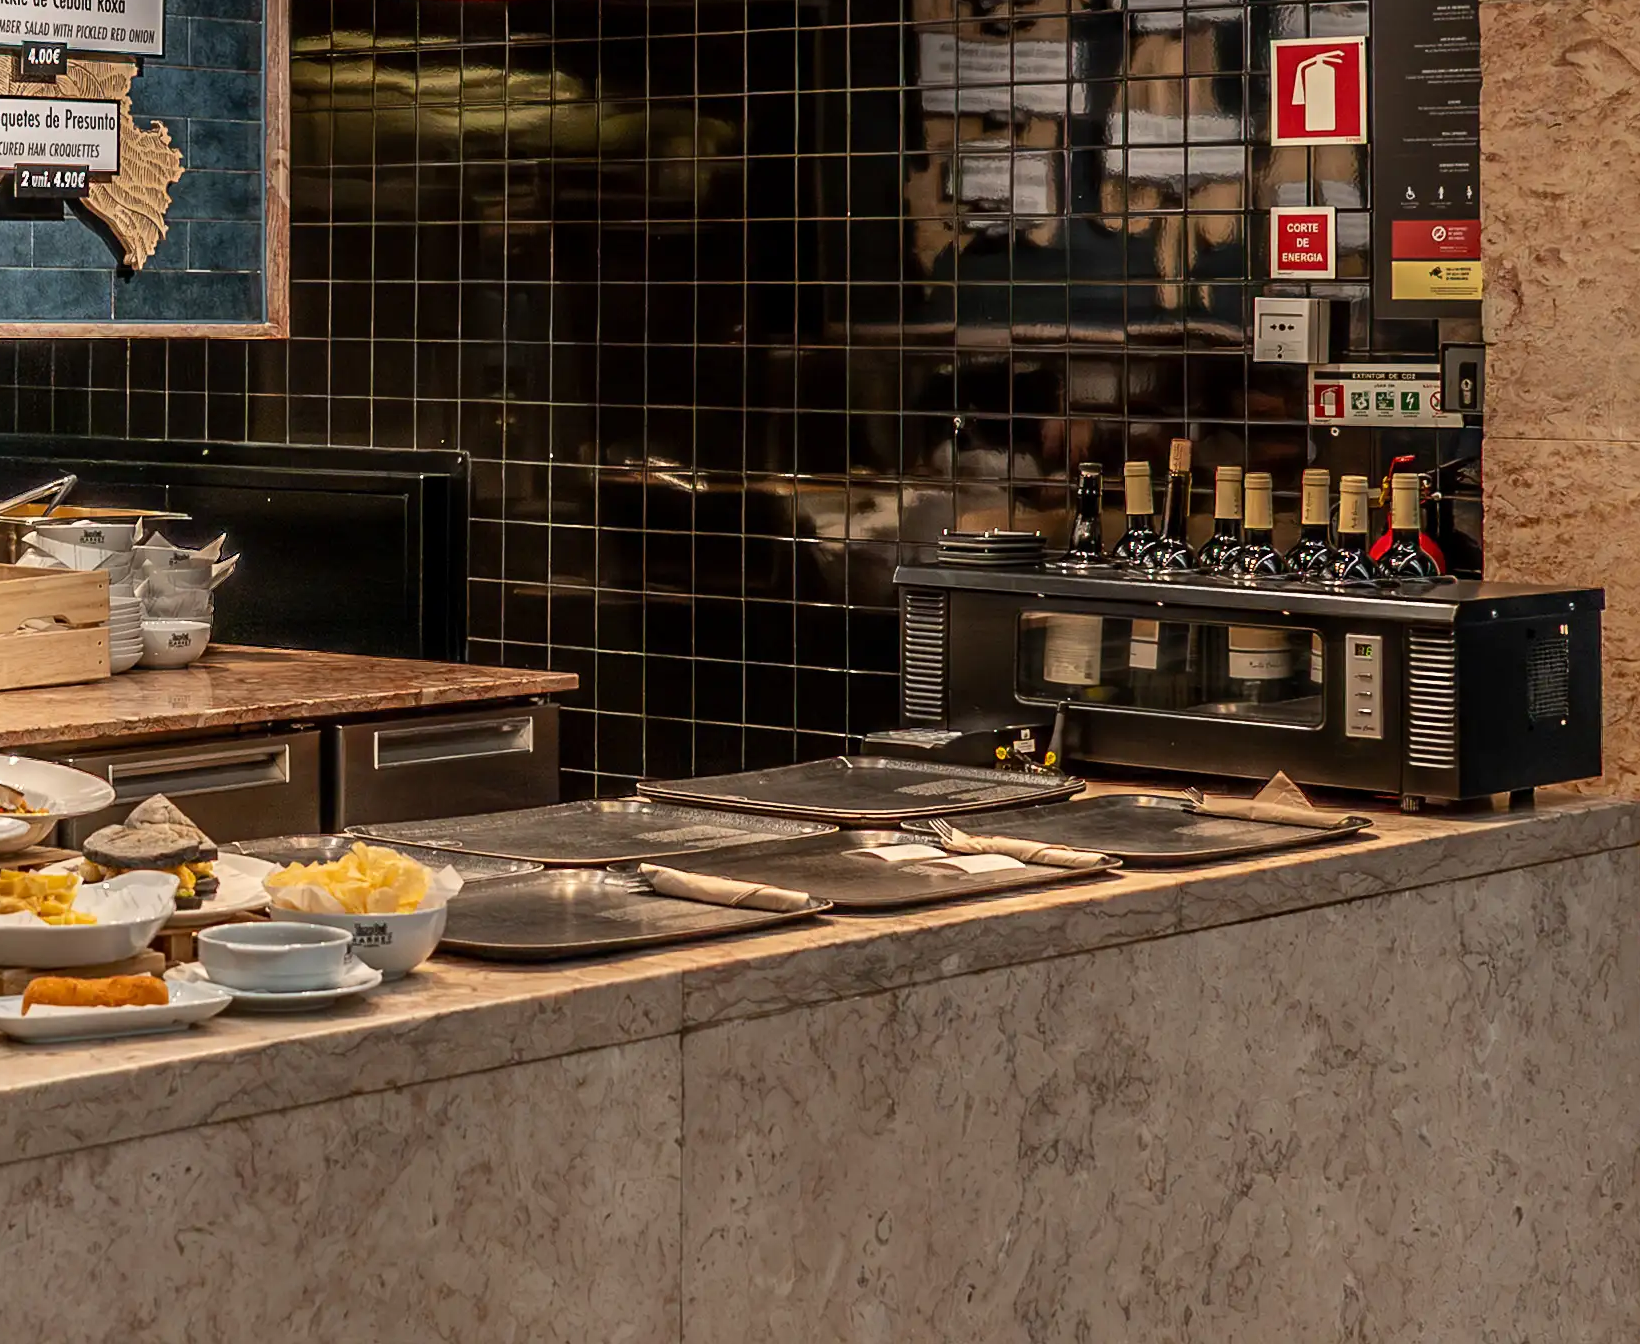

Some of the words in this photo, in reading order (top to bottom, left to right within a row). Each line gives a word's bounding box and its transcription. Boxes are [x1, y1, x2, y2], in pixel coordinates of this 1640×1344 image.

[45, 107, 60, 128] de
[65, 111, 116, 131] Presunto
[28, 142, 46, 157] HAM
[49, 142, 100, 158] CROQUETTES
[21, 170, 29, 186] 2
[32, 171, 52, 187] uni.
[53, 171, 86, 188] 4.90€
[1286, 221, 1320, 235] CORTE
[1296, 237, 1310, 248] DE
[1281, 251, 1323, 264] ENERGIA
